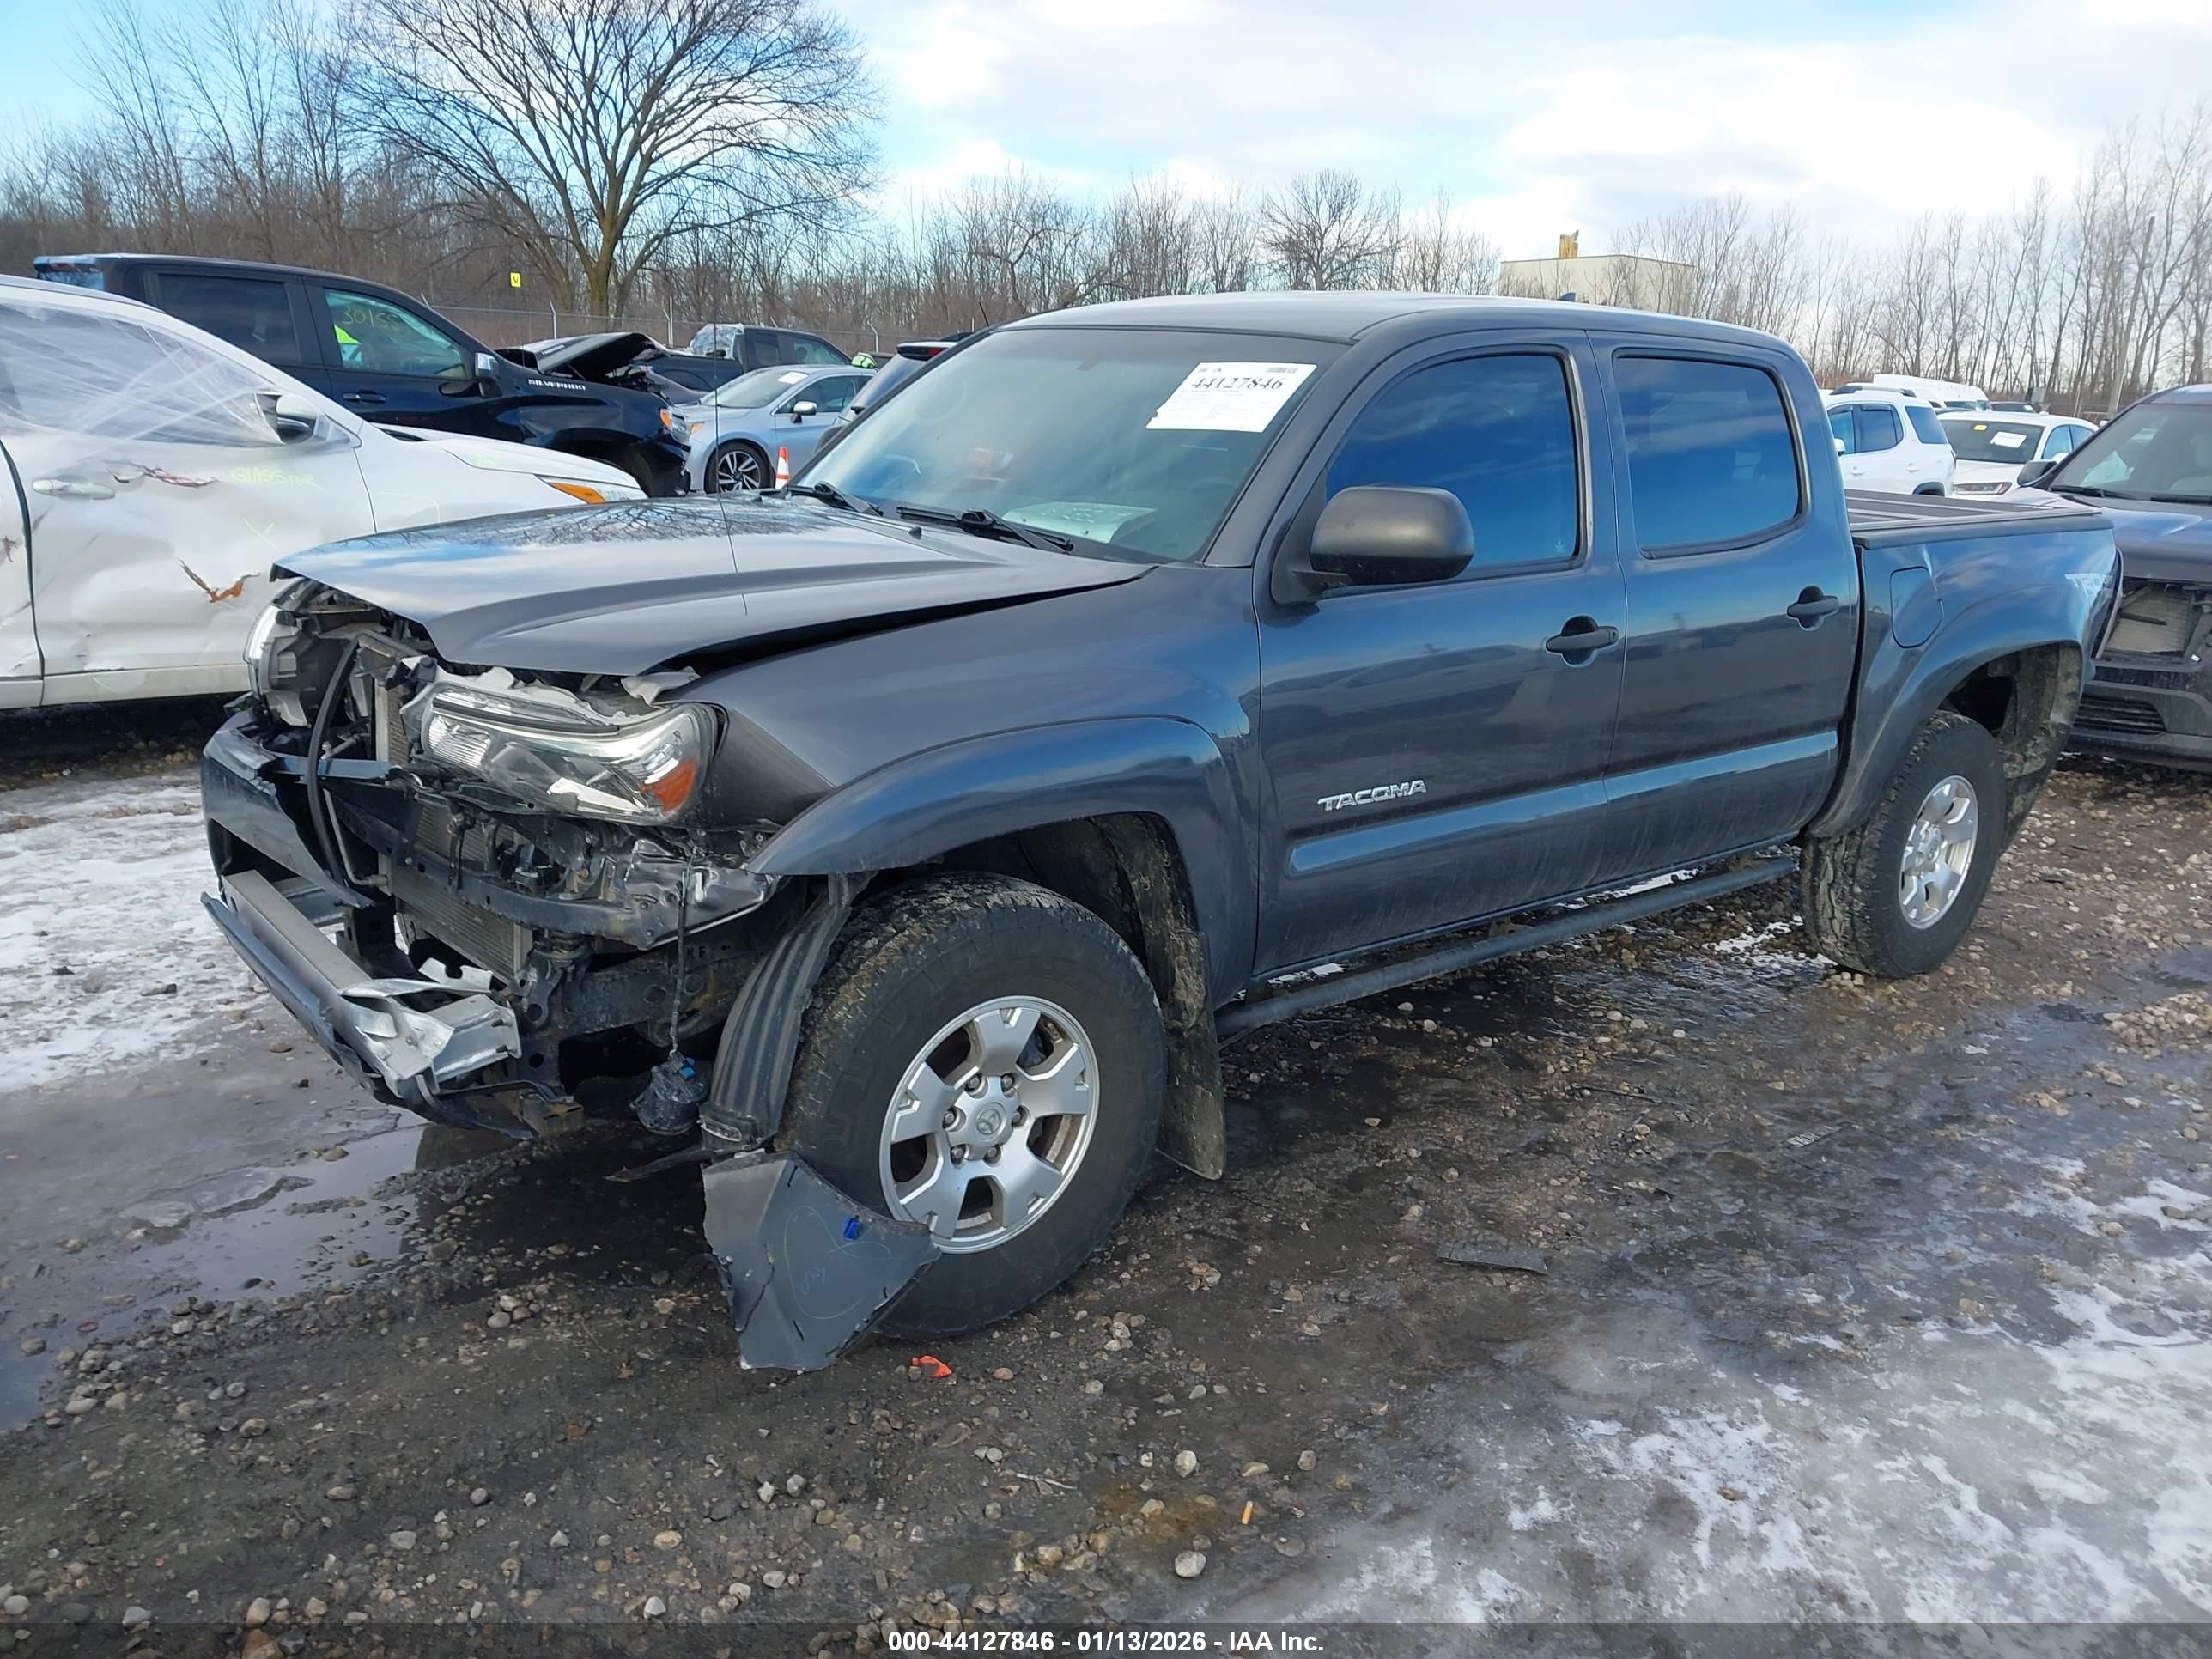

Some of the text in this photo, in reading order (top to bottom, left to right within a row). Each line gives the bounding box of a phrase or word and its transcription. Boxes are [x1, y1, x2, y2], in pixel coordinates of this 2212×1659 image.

[527, 379, 586, 391] SILVERADO
[1190, 376, 1285, 390] 44127846
[1317, 780, 1427, 811] TACOMA
